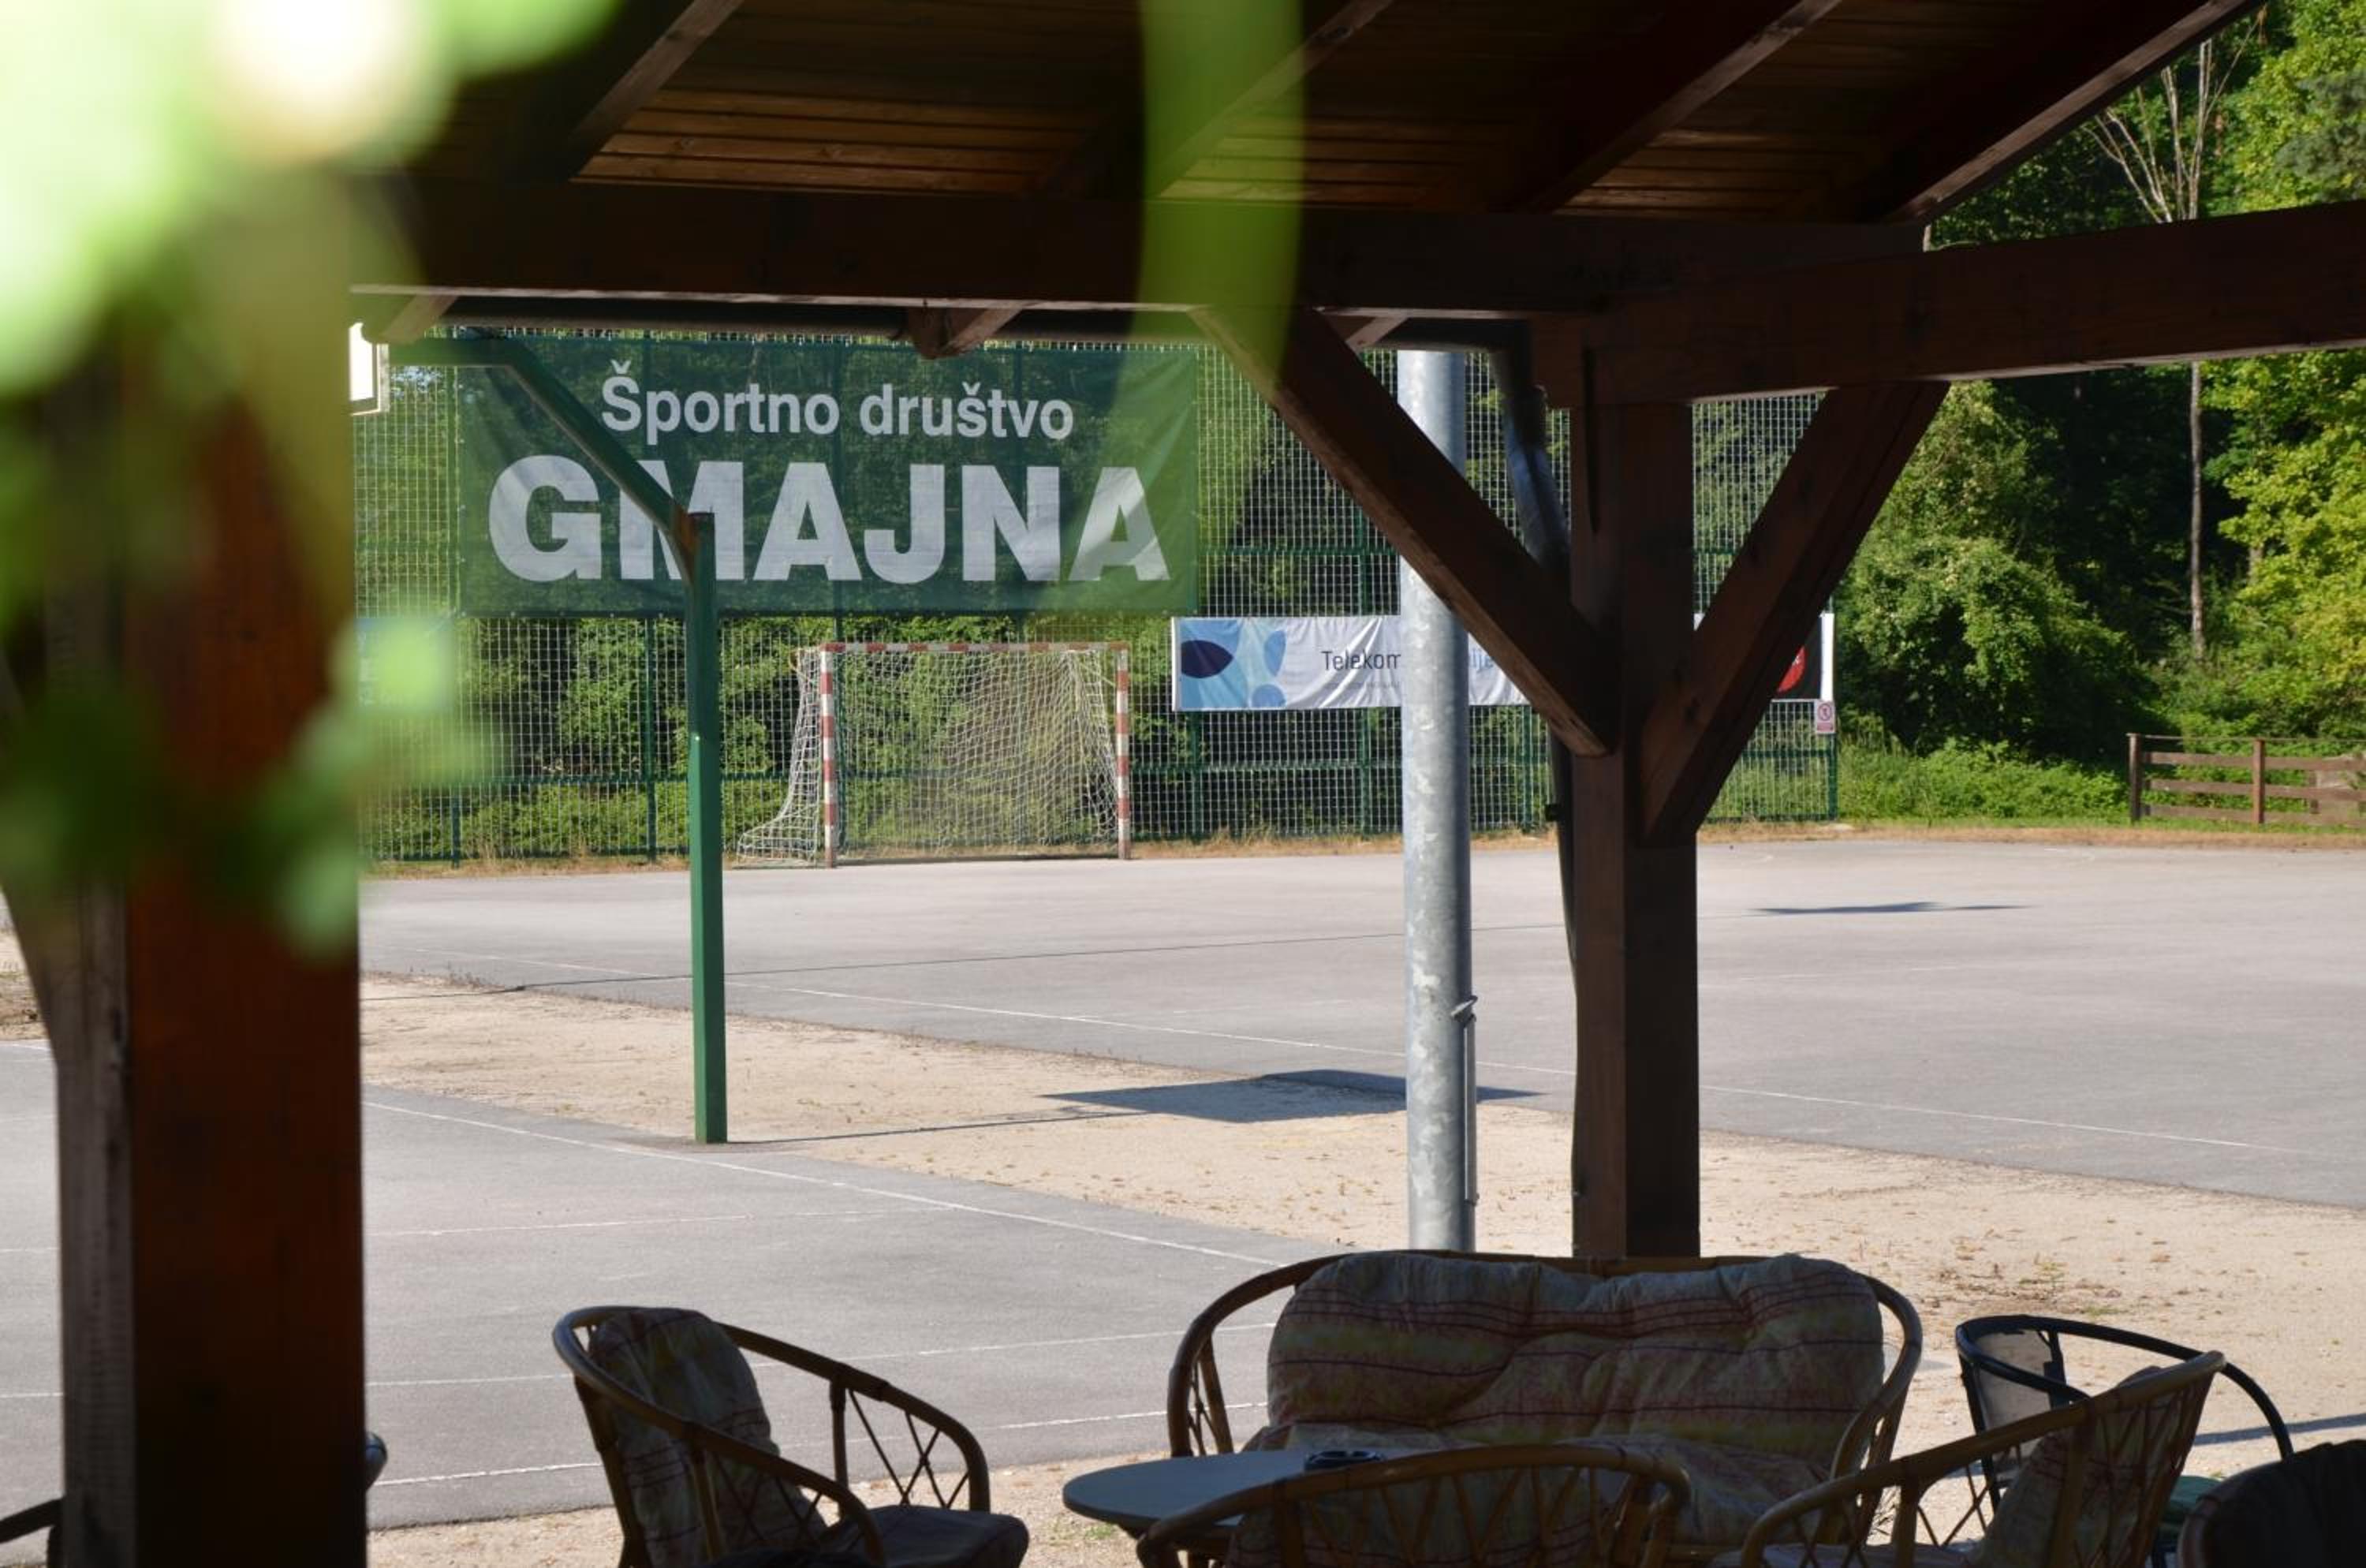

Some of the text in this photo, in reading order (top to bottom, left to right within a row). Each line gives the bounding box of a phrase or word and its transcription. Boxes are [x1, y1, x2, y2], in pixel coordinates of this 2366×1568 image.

[602, 360, 1073, 445] Športno društvo
[489, 455, 1170, 584] GMAJNA
